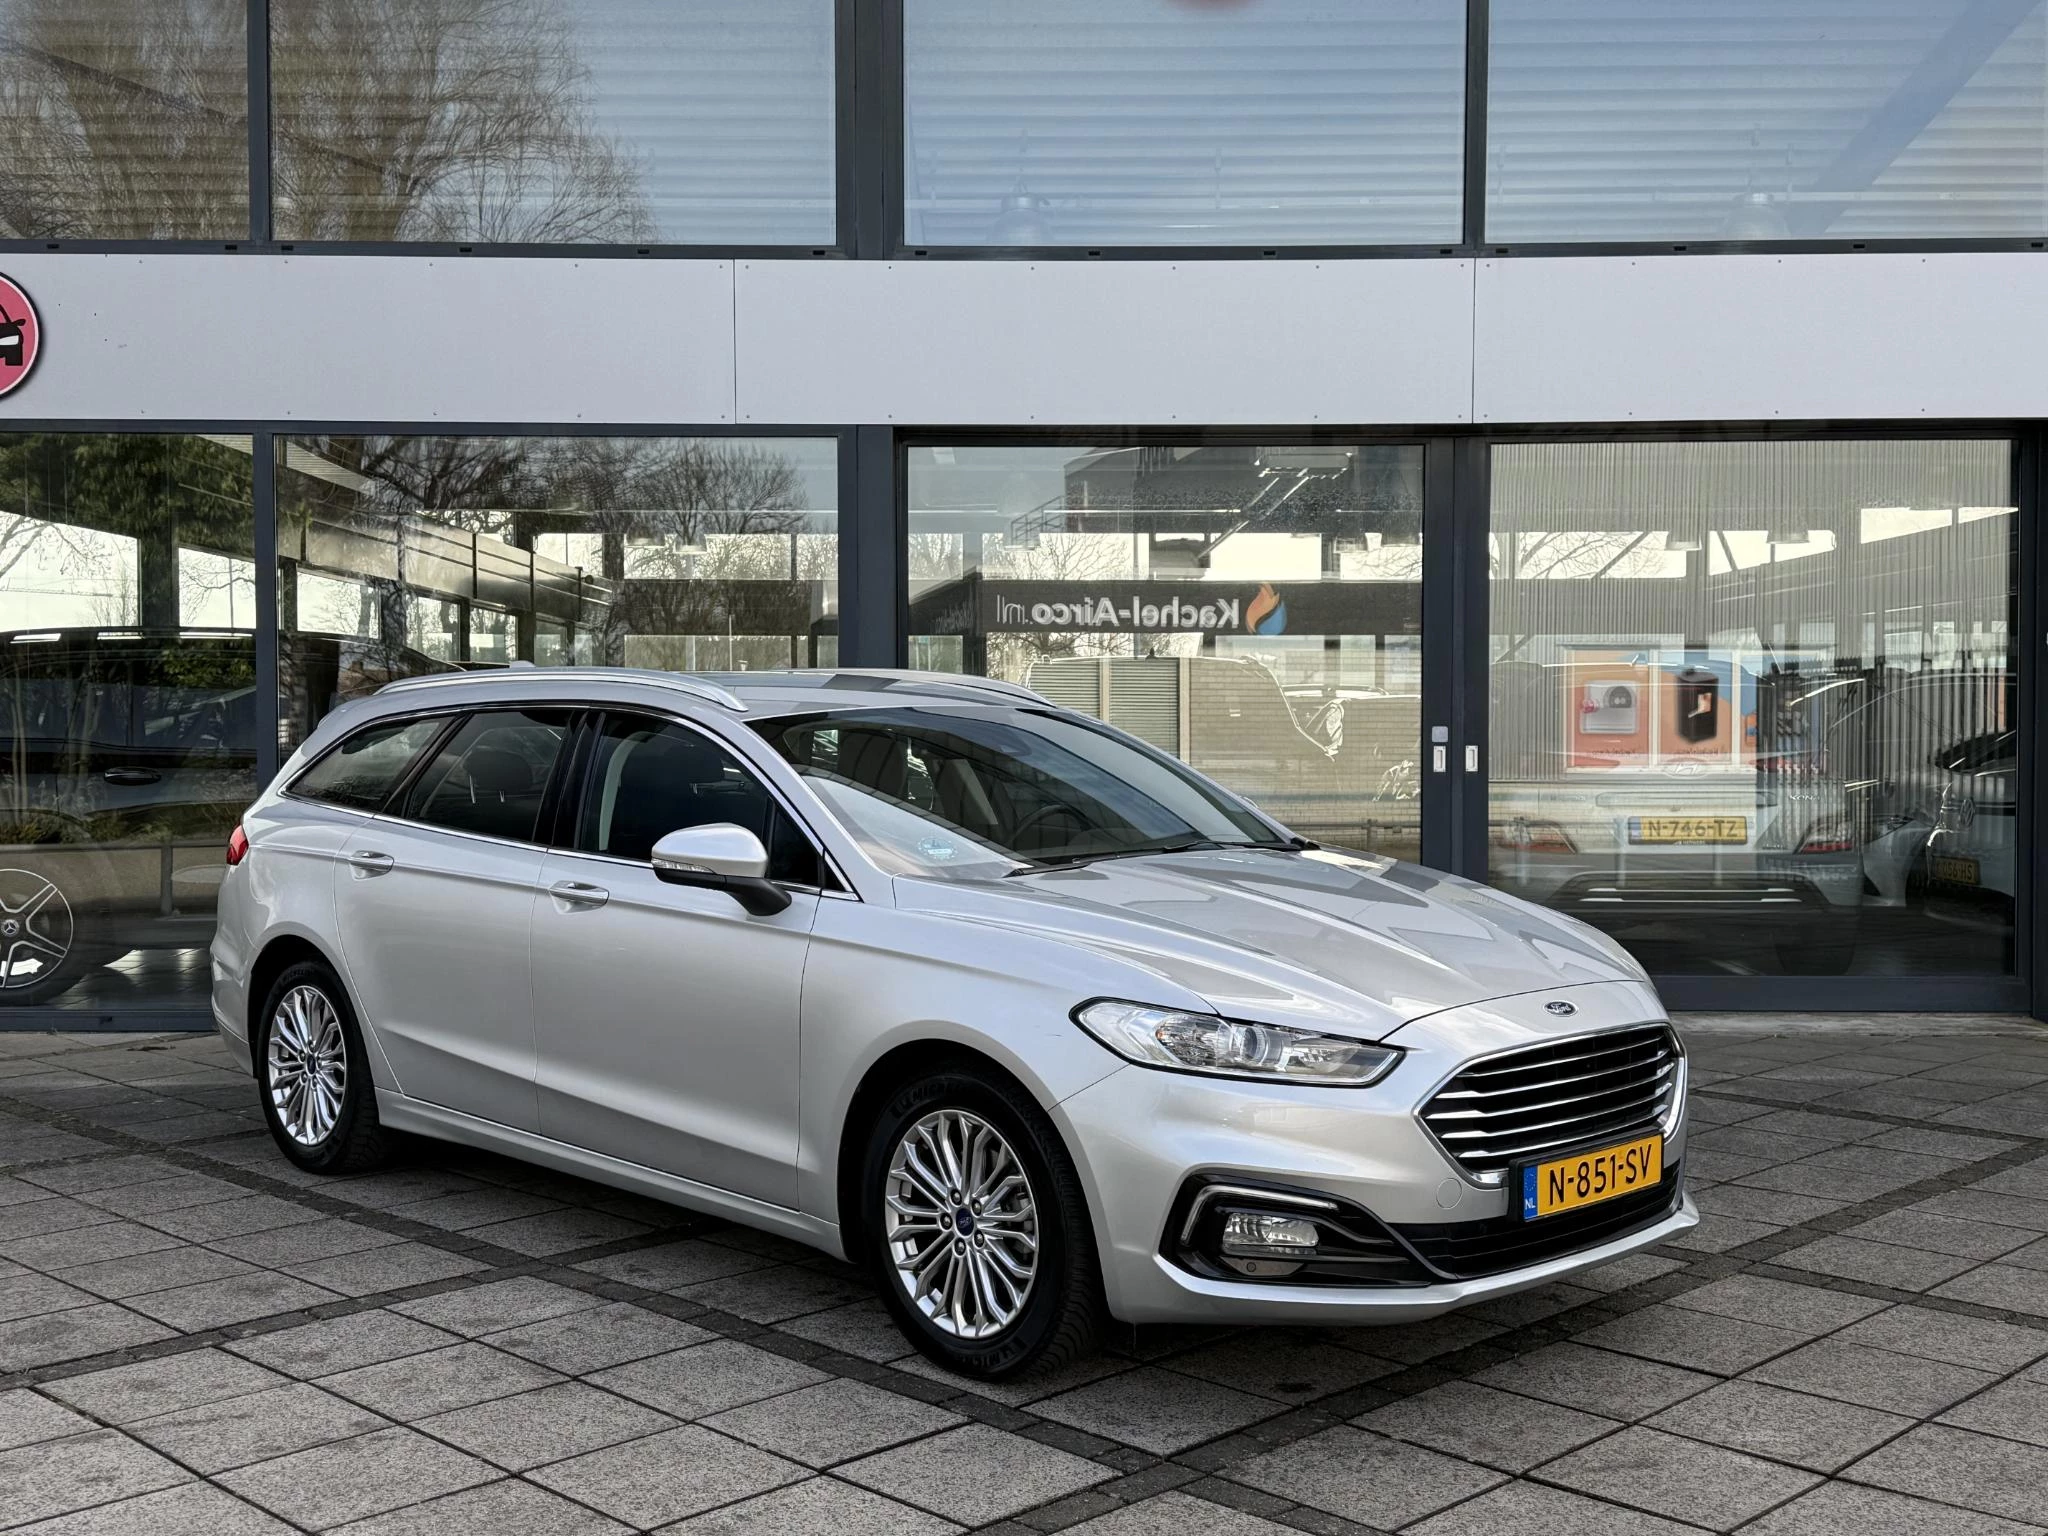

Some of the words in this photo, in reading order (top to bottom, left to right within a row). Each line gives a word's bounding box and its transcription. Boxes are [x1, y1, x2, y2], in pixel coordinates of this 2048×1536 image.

[1648, 819, 1738, 837] N-746-TZ
[1547, 1003, 1572, 1013] Ford
[1550, 1144, 1652, 1205] N-851-SV
[1525, 1197, 1536, 1211] NL
